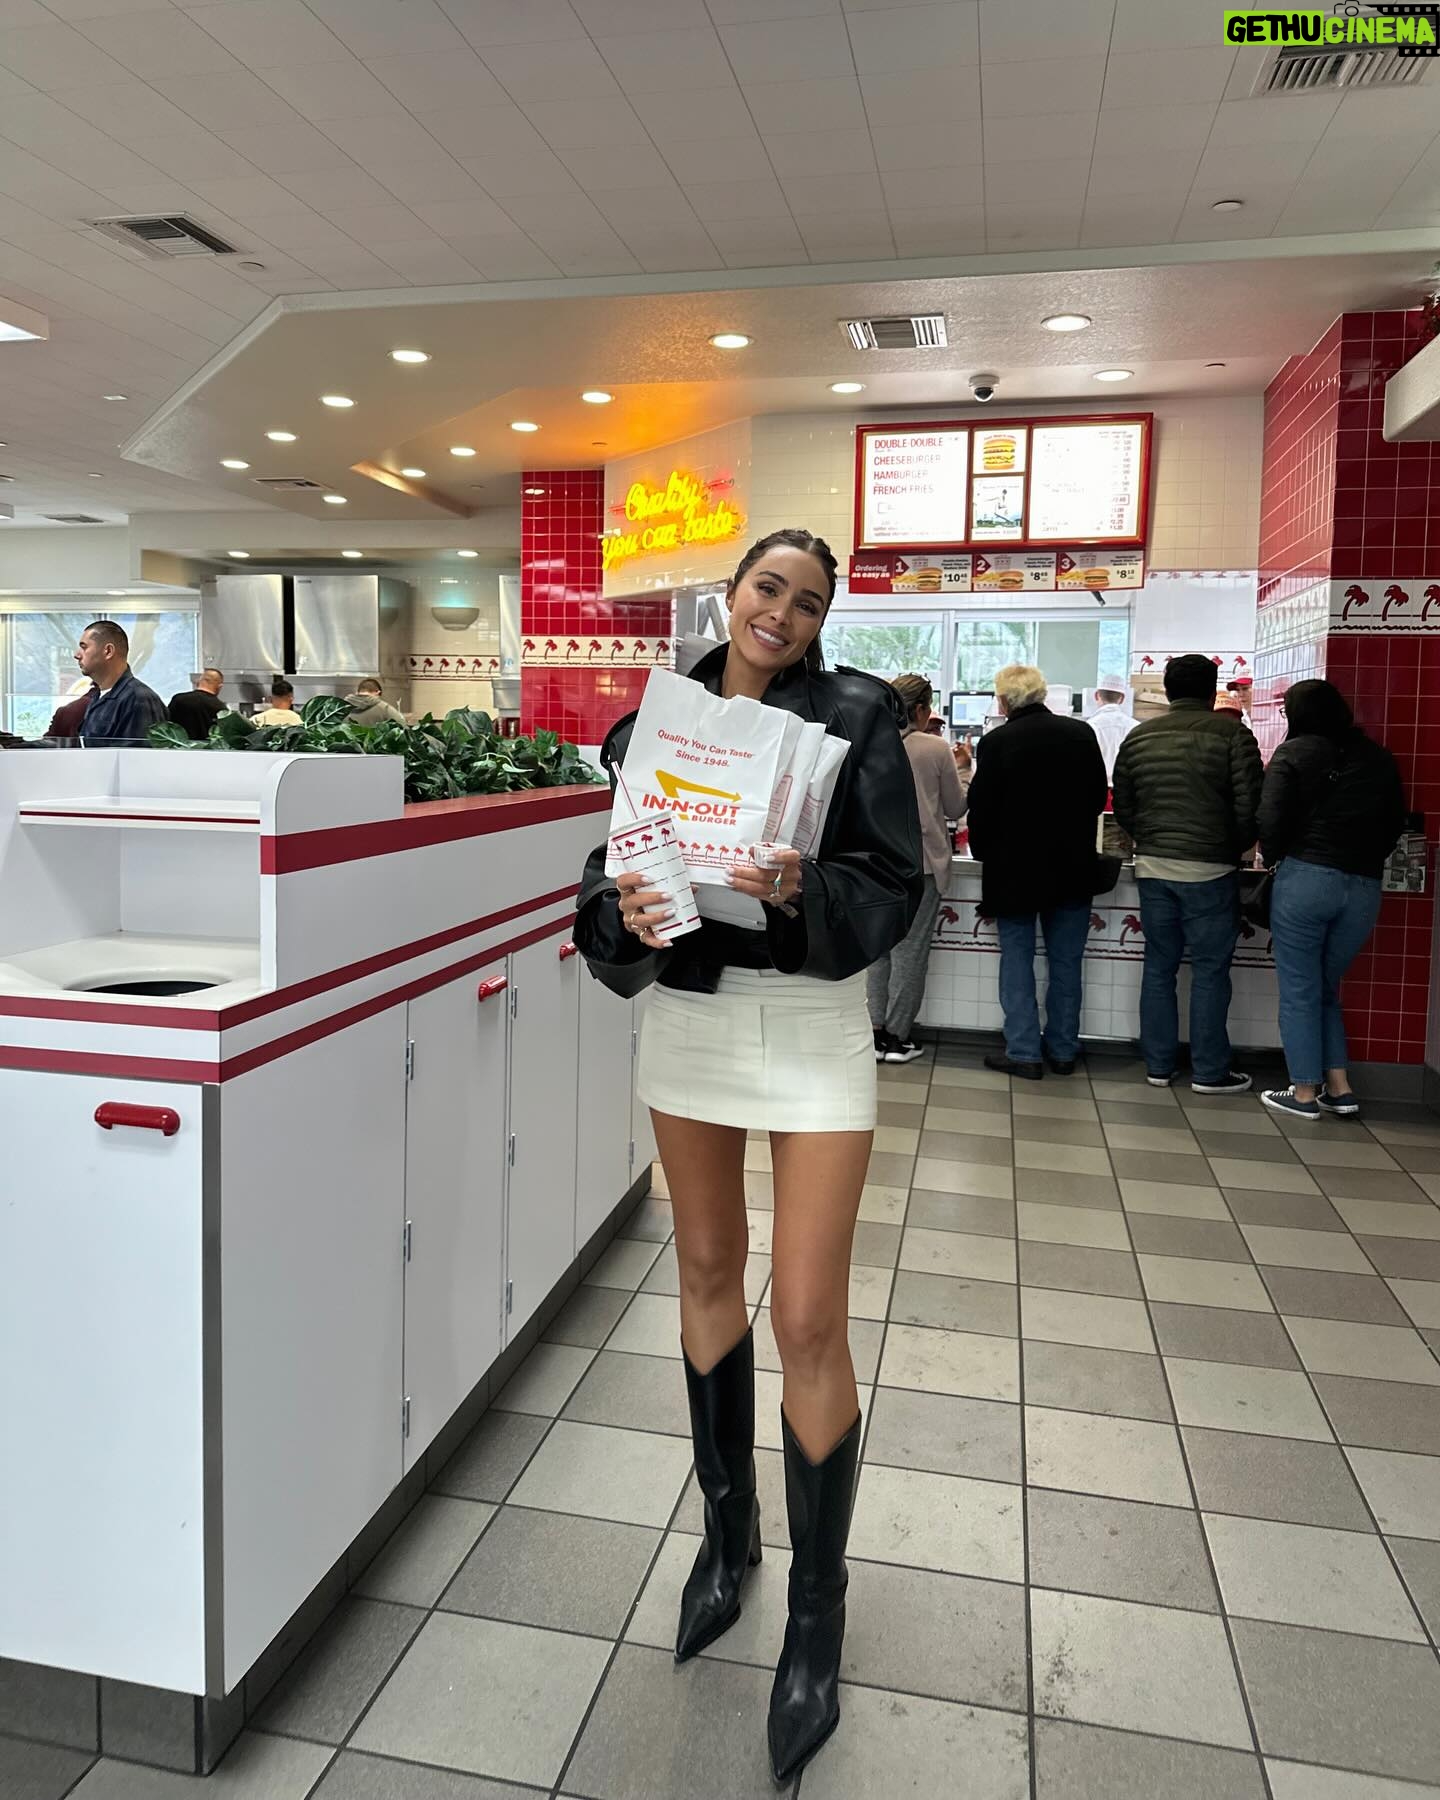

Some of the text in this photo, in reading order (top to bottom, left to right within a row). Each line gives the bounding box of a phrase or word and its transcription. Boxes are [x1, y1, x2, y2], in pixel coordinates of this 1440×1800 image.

[873, 454, 941, 466] CHEESEBURGER
[625, 471, 701, 521] Quality
[873, 485, 907, 496] FRENCH
[855, 564, 888, 573] Ordering
[895, 561, 904, 573] 1
[976, 560, 986, 571] 2
[1060, 558, 1071, 569] 3
[862, 572, 880, 580] easy
[657, 729, 753, 760] Quality You Can Taste
[675, 749, 701, 763] Since
[641, 793, 742, 818] IN-N-OUT
[691, 815, 737, 826] BURGER
